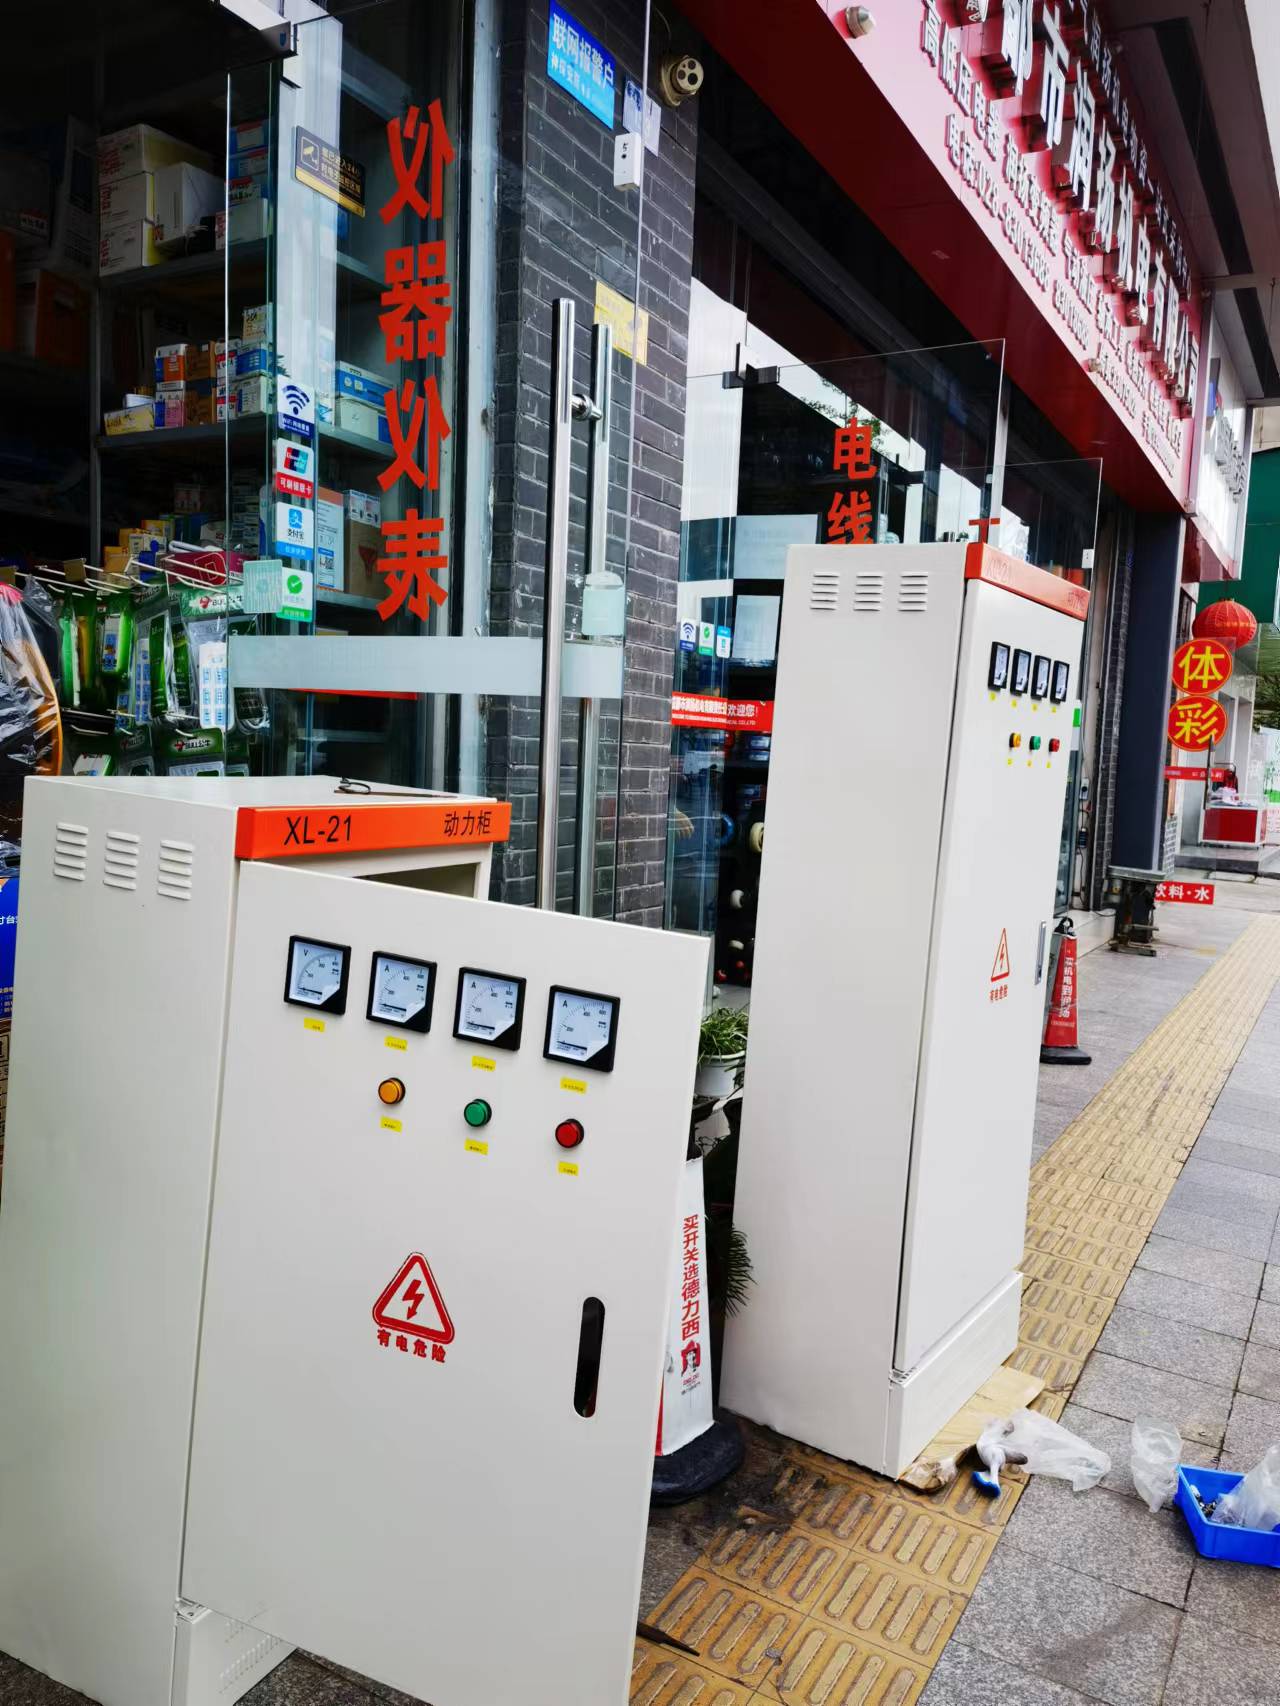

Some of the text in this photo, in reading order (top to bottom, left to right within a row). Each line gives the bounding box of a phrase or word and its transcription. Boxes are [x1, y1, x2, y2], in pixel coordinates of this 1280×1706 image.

[552, 13, 614, 89] 联网报警户
[287, 528, 304, 540] 支付宝
[284, 815, 352, 846] XL-21
[443, 810, 493, 837] 动力柜
[303, 948, 309, 956] V
[384, 964, 390, 972] A
[471, 981, 477, 989] A
[562, 999, 569, 1008] A
[681, 1214, 700, 1341] 买开关选德力西
[377, 1328, 446, 1363] 有电危险
